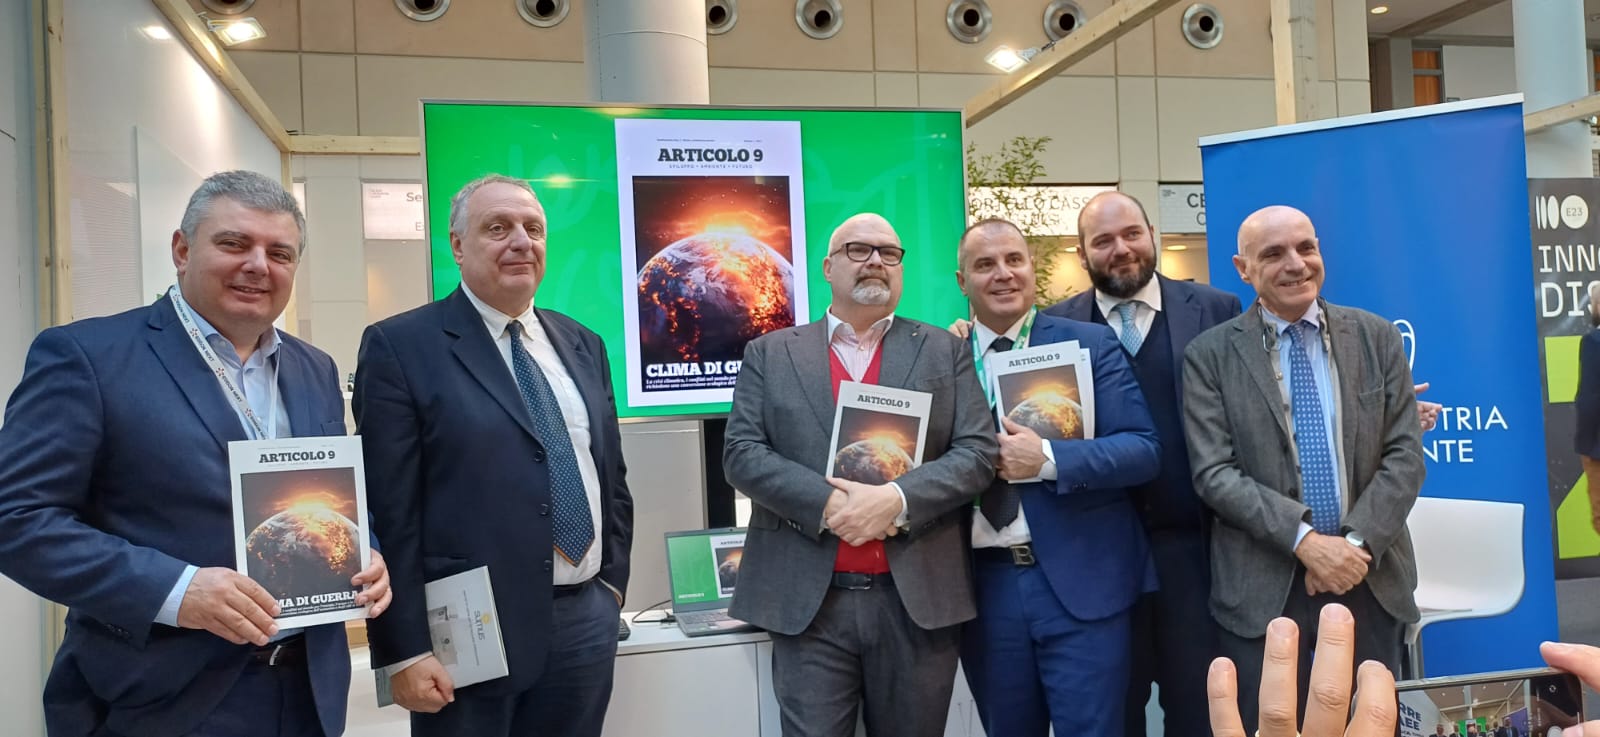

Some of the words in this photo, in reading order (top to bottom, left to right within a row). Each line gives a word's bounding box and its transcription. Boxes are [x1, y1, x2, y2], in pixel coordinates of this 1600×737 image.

[658, 148, 750, 162] ARTICOLO
[753, 149, 763, 162] 9
[1566, 207, 1584, 217] E23
[1538, 244, 1600, 273] INN
[1008, 354, 1054, 367] ARTICOLO
[646, 362, 702, 377] CLIMA
[704, 361, 723, 375] DI
[857, 394, 904, 408] ARTICOLO
[904, 401, 911, 409] 9
[1434, 405, 1508, 431] TRIA
[259, 451, 326, 463] ARTICOLO
[327, 450, 336, 459] 9
[295, 596, 309, 606] DI
